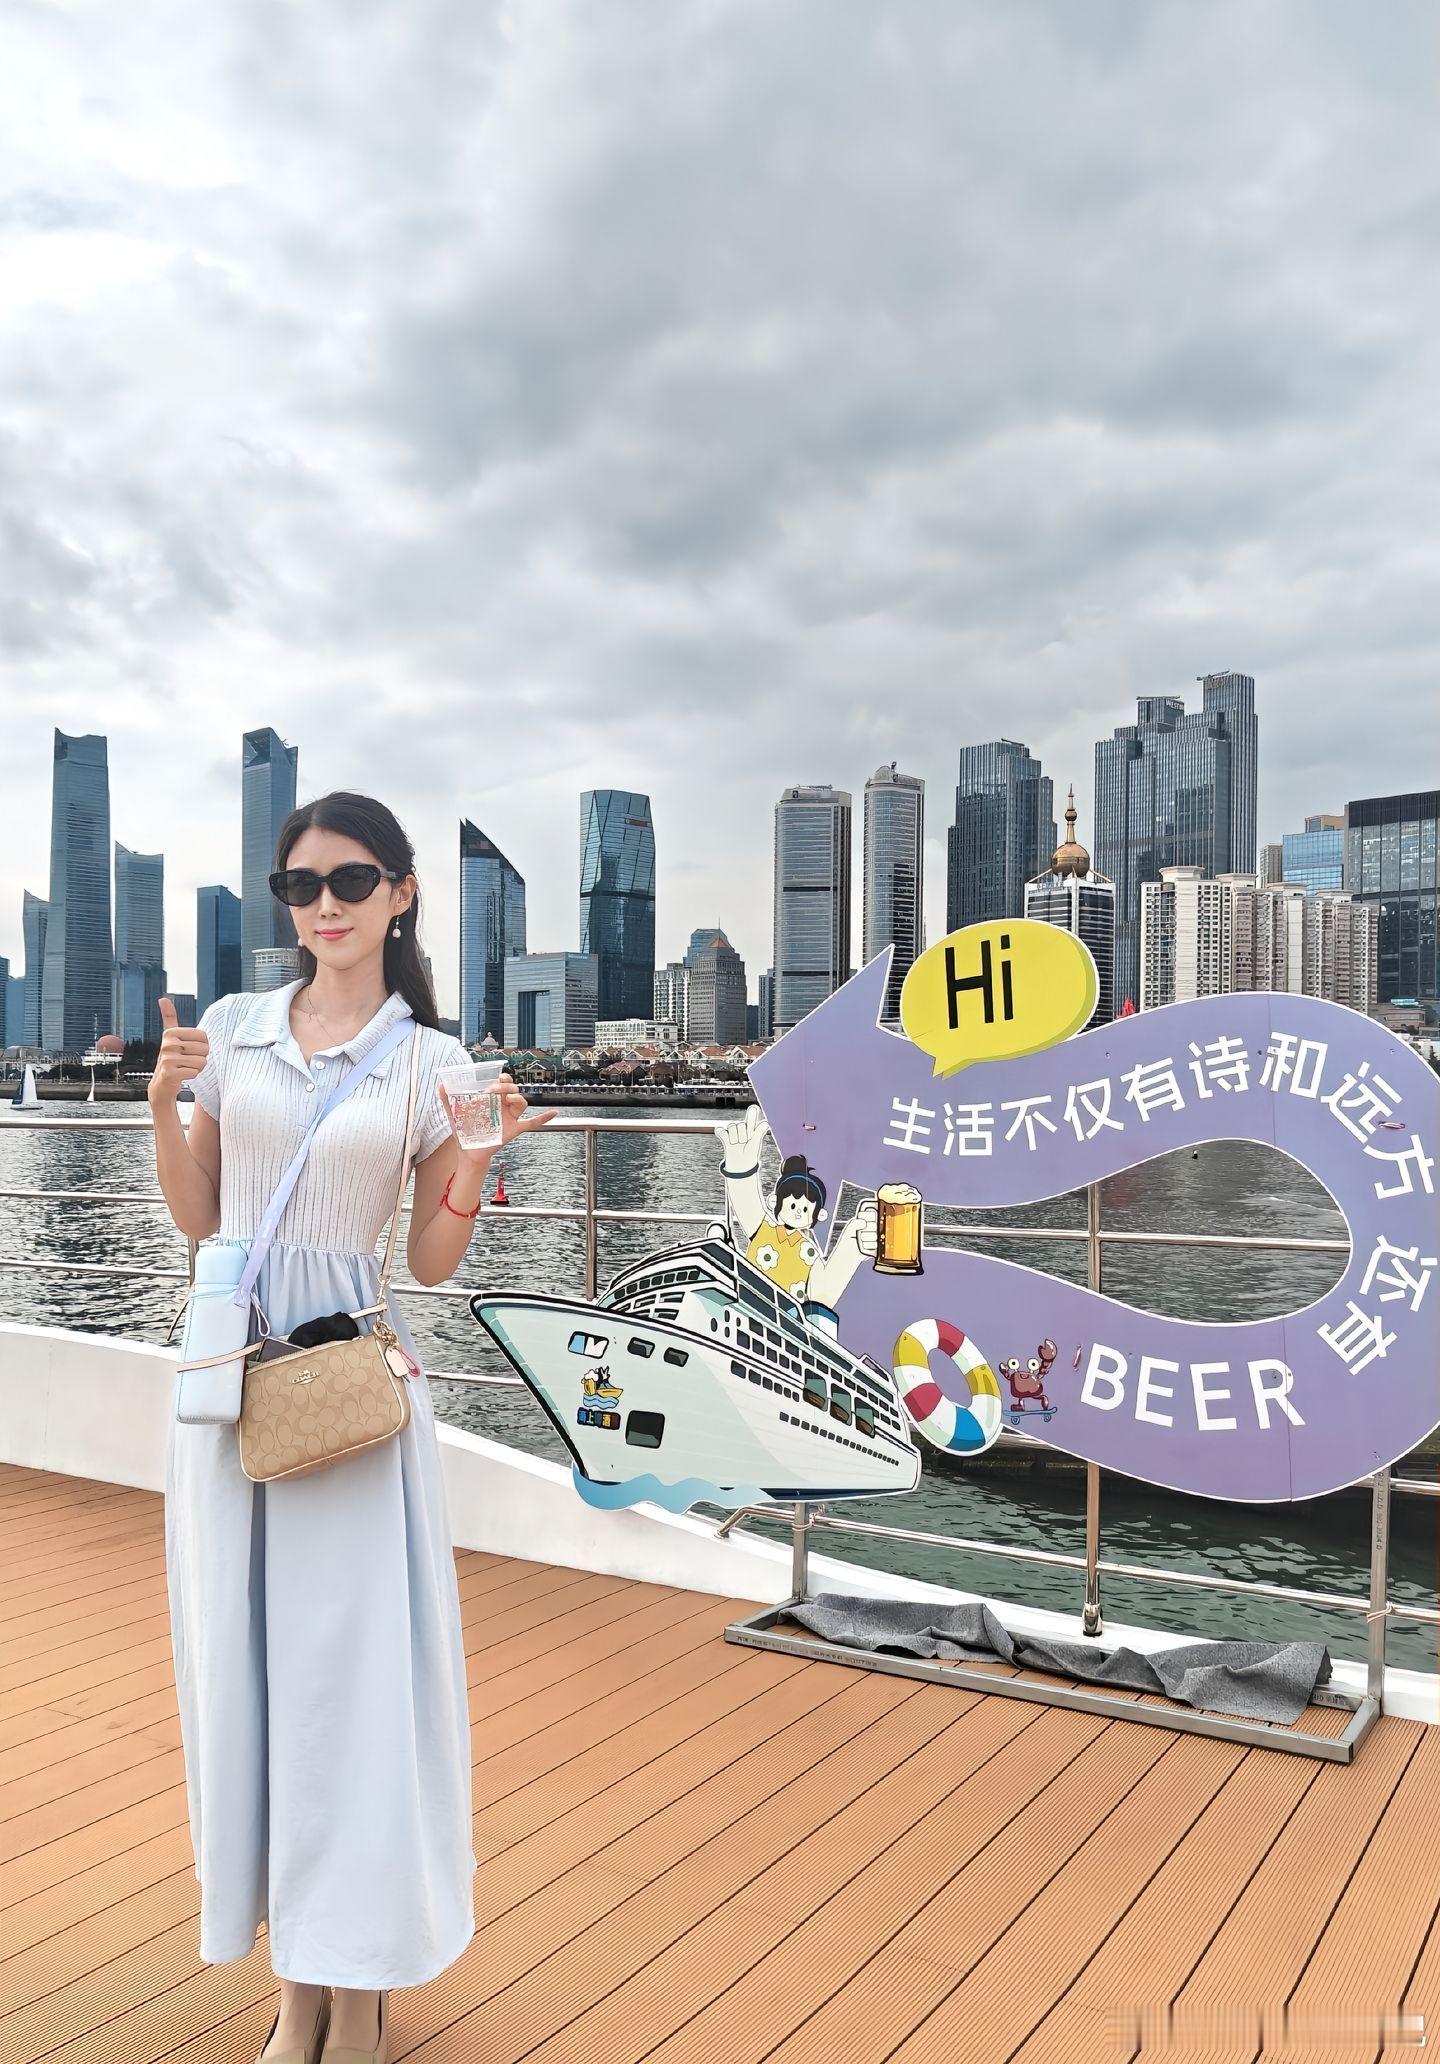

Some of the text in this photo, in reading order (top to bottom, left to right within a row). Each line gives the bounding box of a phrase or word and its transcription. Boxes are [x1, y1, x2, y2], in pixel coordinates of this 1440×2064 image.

[944, 934, 1014, 1030] Hi
[882, 1031, 1438, 1376] 生活不仅有诗和远方 还有
[1079, 1341, 1306, 1431] BEER
